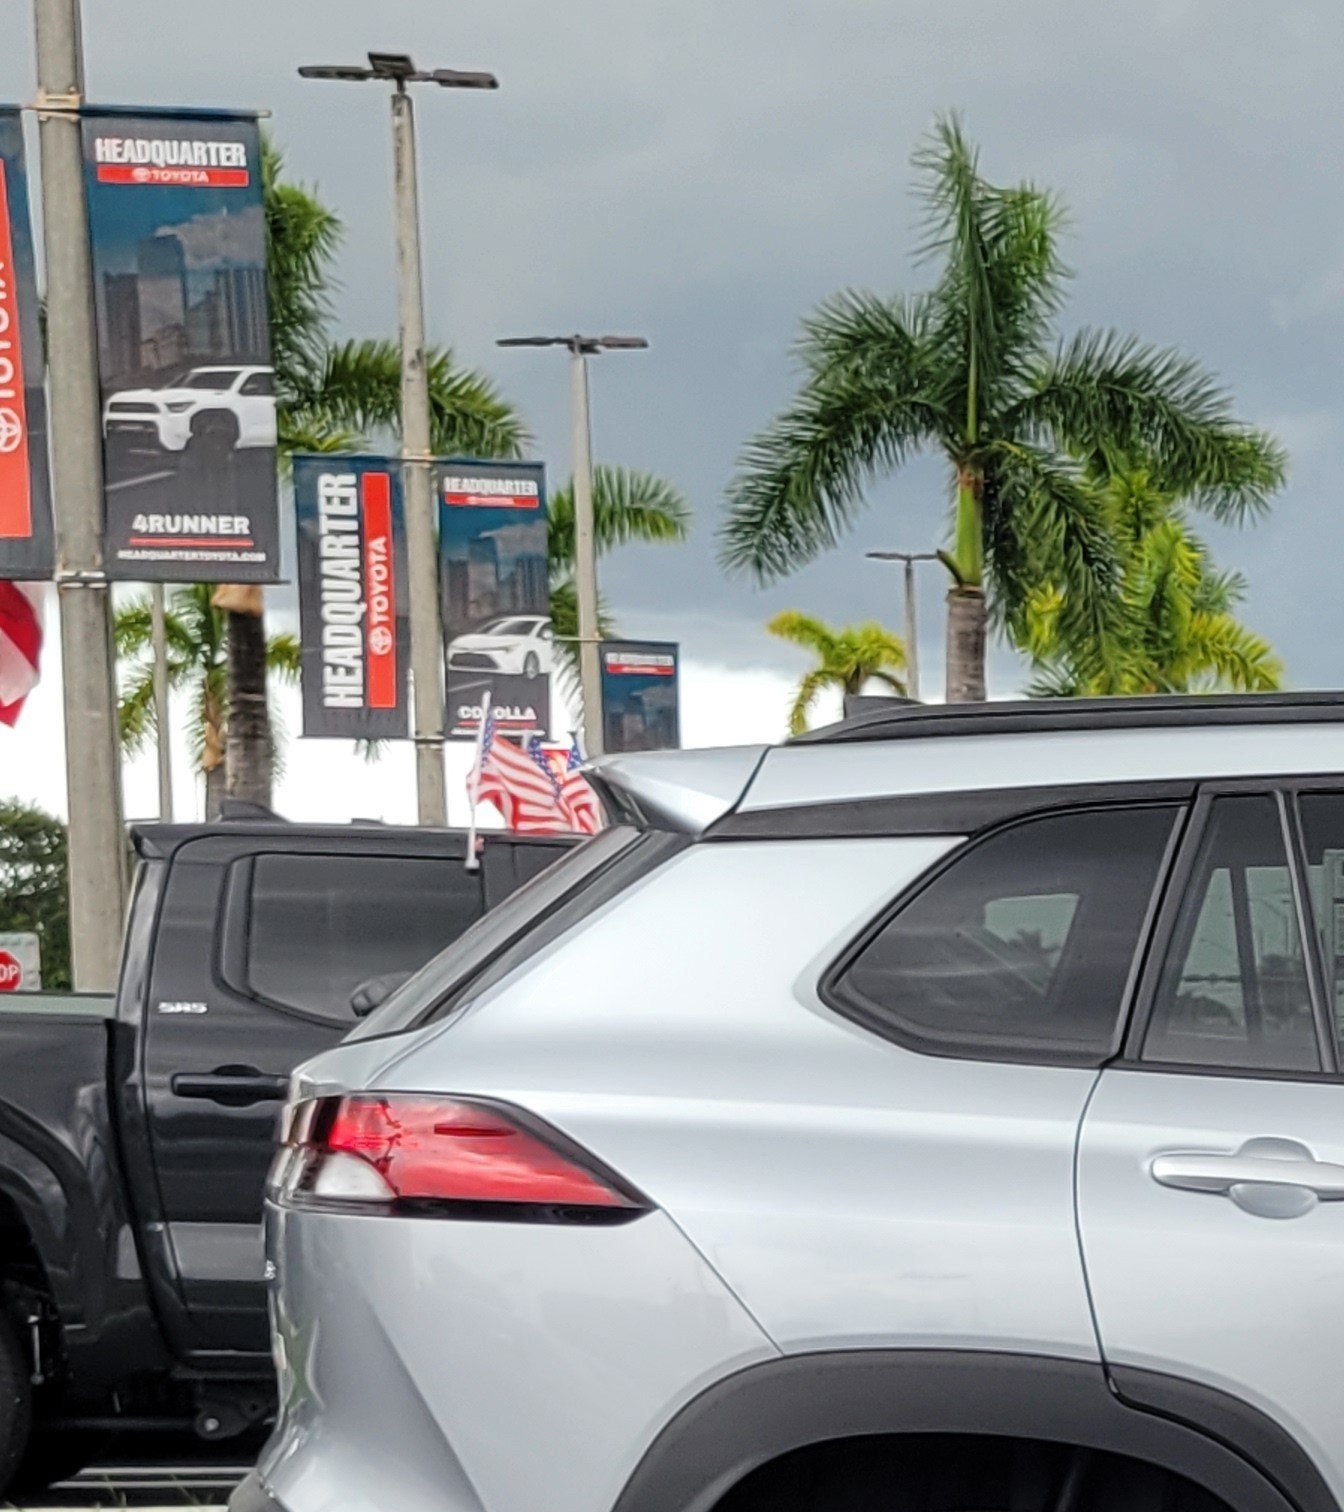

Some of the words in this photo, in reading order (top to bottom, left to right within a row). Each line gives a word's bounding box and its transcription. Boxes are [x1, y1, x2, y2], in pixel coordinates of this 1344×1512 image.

[95, 137, 246, 167] HEADQUARTER
[151, 170, 209, 182] TOYOTA
[132, 513, 250, 534] 4RUNNER
[318, 472, 367, 708] HEADQUARTER
[369, 536, 389, 624] TOYOTA
[457, 705, 537, 720] COOLLA
